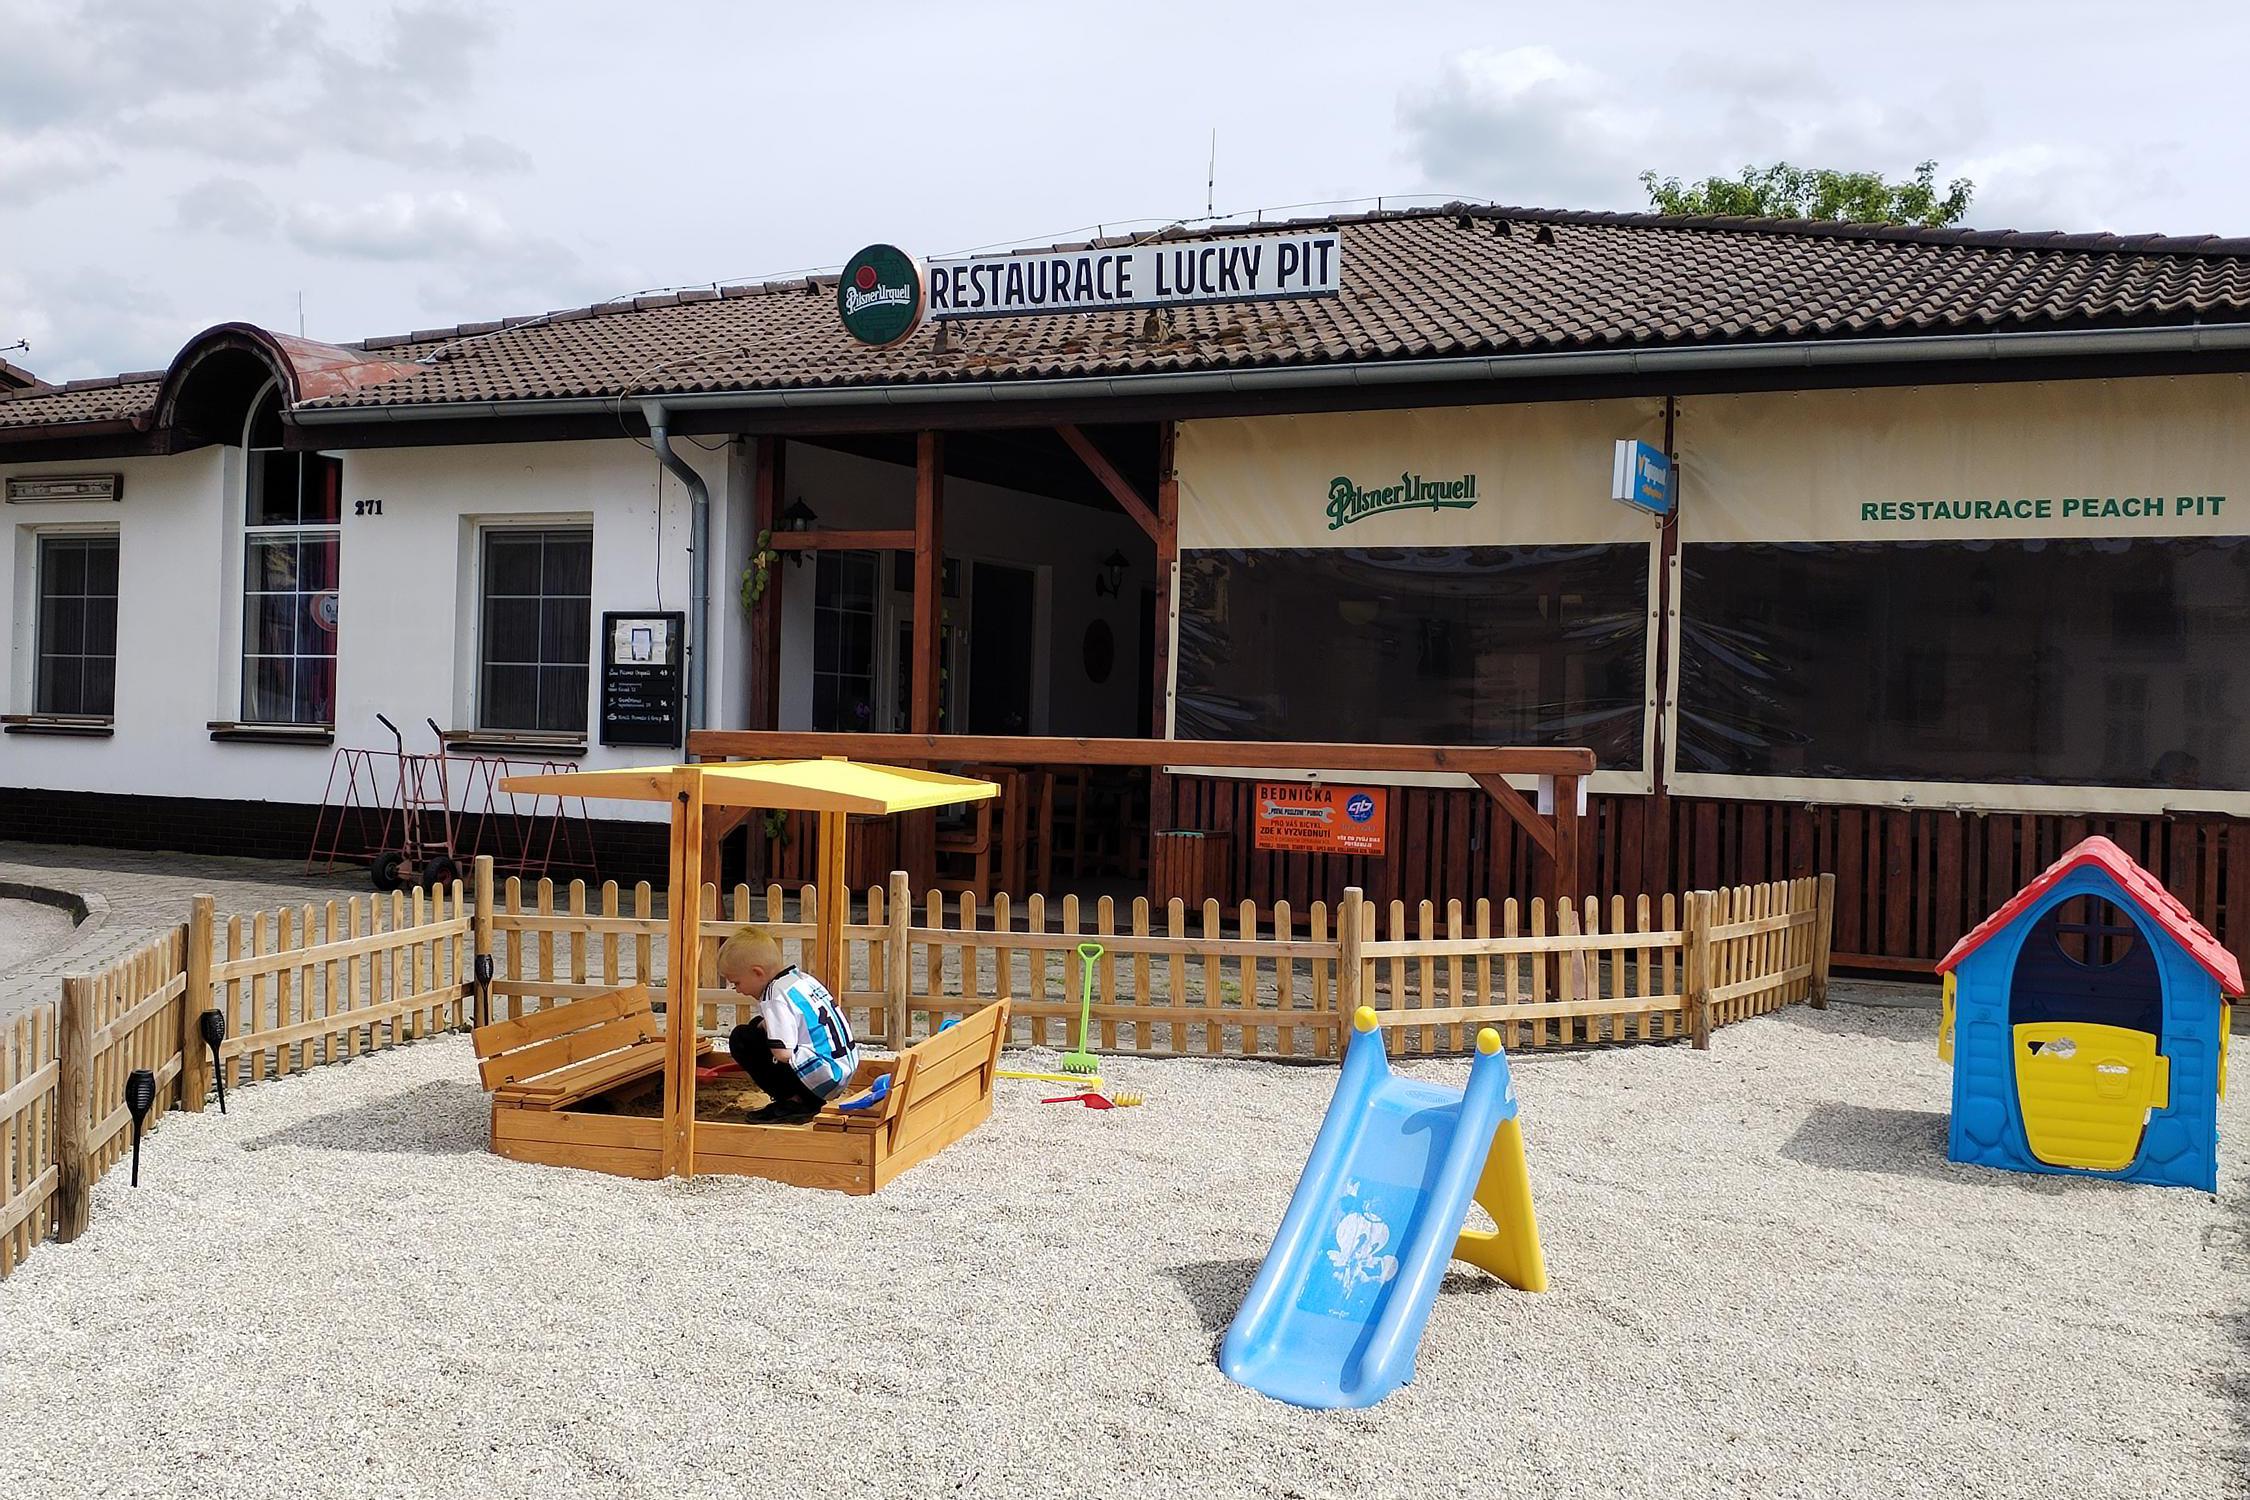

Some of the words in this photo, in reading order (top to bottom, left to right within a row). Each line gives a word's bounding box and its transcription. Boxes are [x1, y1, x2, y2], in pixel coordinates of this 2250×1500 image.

[930, 254, 1133, 309] RESTAURACE
[1155, 245, 1262, 296] LUCKY
[1277, 239, 1335, 288] PIT
[846, 285, 879, 315] Pilsner
[877, 283, 911, 305] Urquell
[354, 499, 383, 516] 271
[1327, 475, 1405, 531] Pilsner
[1401, 471, 1476, 512] Urquell
[1861, 499, 2052, 521] RESTAURACE
[2062, 497, 2164, 518] PEACH
[2176, 496, 2226, 516] PIT
[1260, 826, 1275, 835] ZDE
[1277, 827, 1282, 835] K
